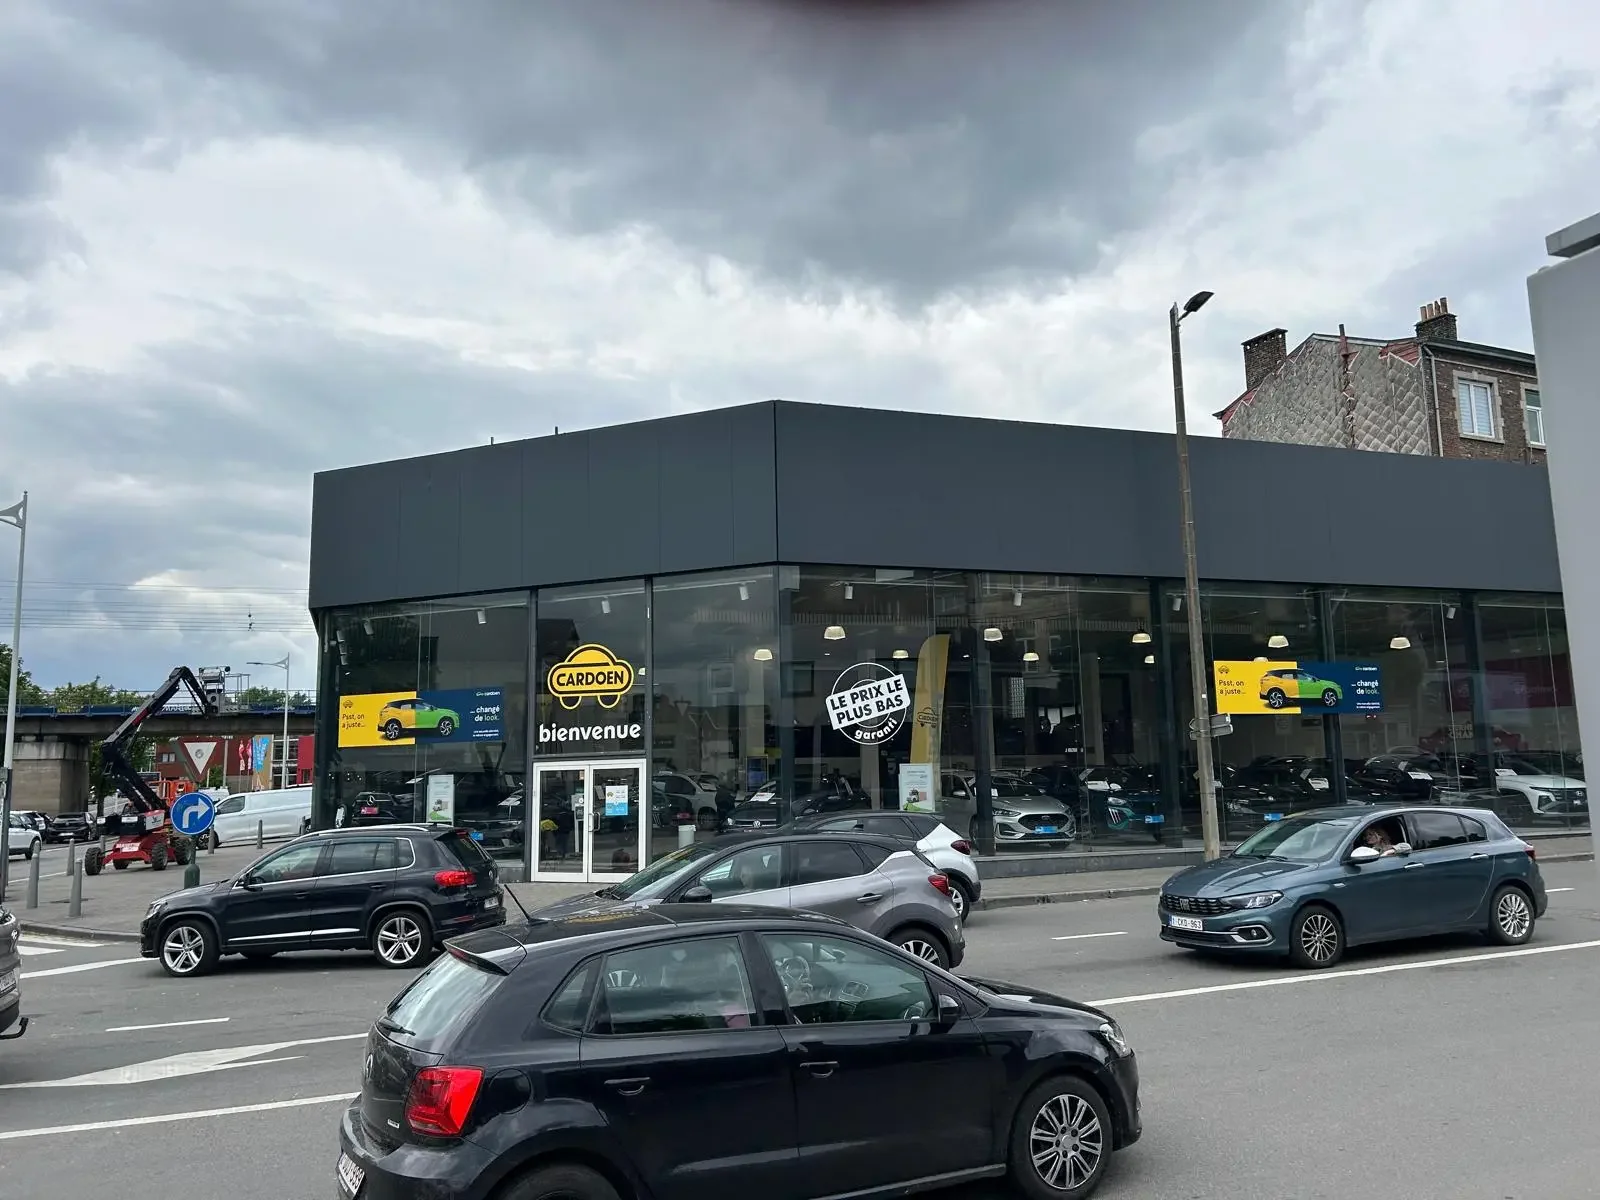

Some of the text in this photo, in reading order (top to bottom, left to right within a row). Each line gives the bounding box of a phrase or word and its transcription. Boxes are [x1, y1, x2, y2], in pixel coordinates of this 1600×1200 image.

[556, 670, 624, 687] CARDOEN
[830, 679, 903, 711] LE PRIX LE
[836, 694, 904, 725] PLUS BAS
[538, 722, 642, 743] bienvenue
[854, 718, 898, 740] garanti
